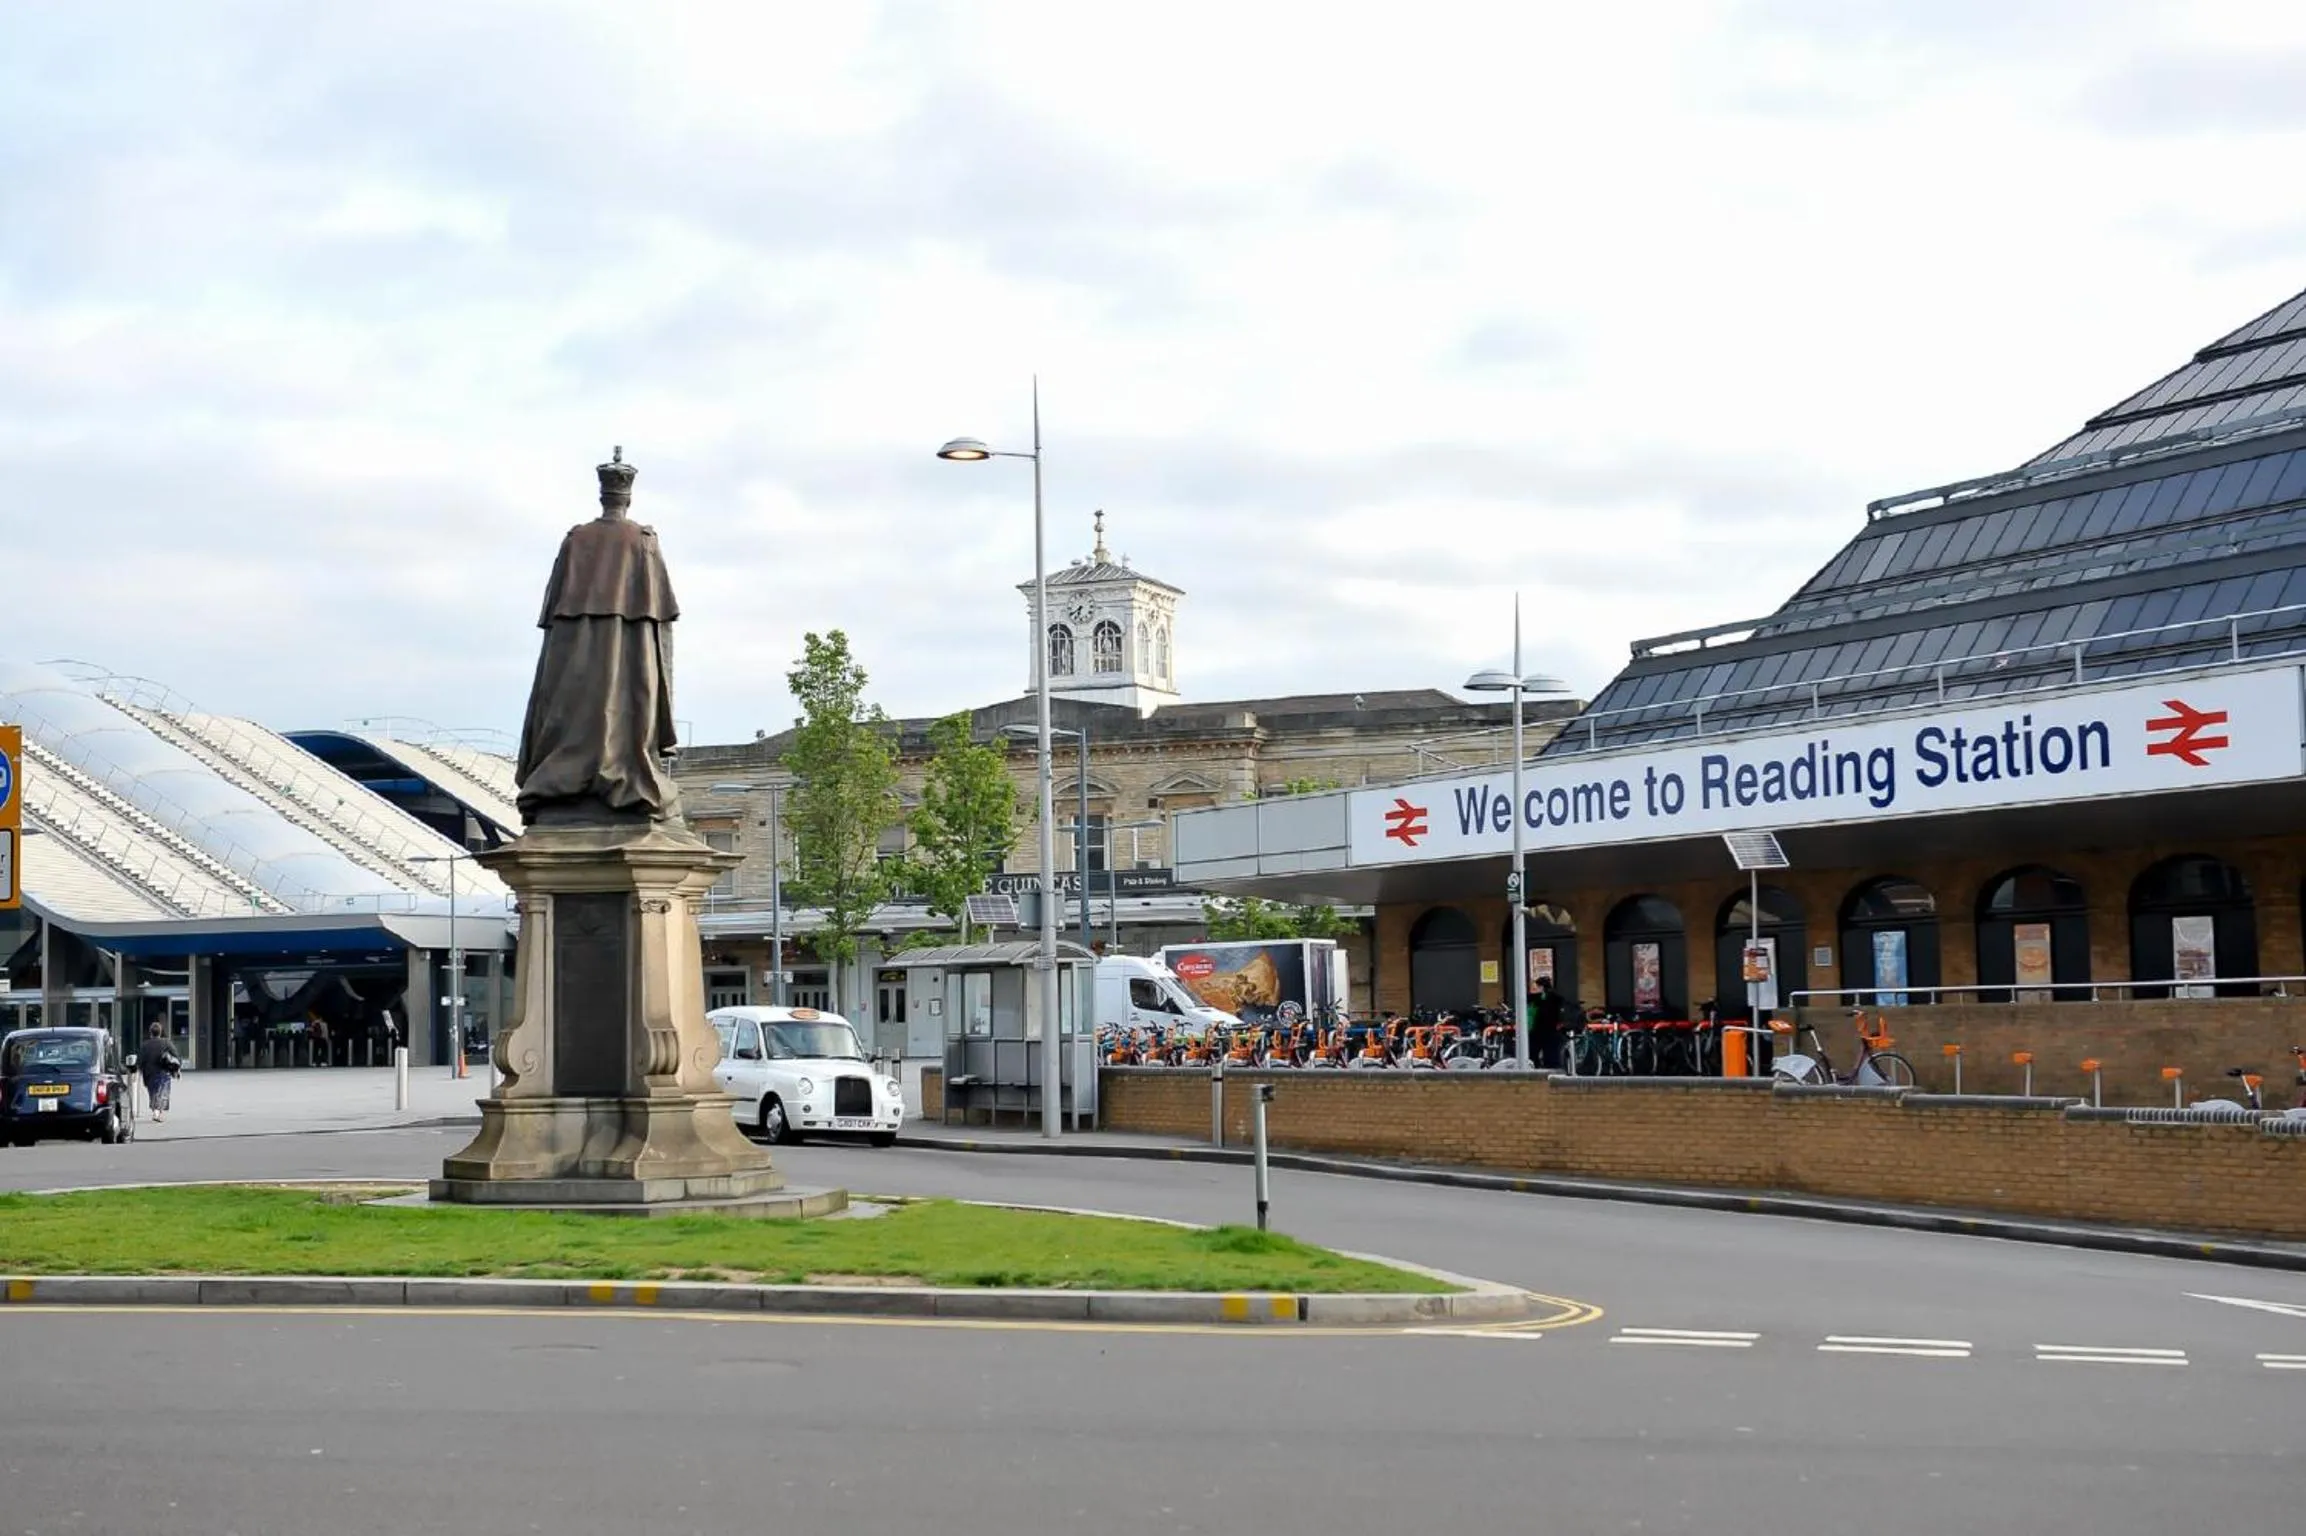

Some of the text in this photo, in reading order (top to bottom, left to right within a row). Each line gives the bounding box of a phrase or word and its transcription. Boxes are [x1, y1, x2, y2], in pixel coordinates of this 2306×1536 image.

[1455, 714, 2110, 835] Wecome to Reading Station
